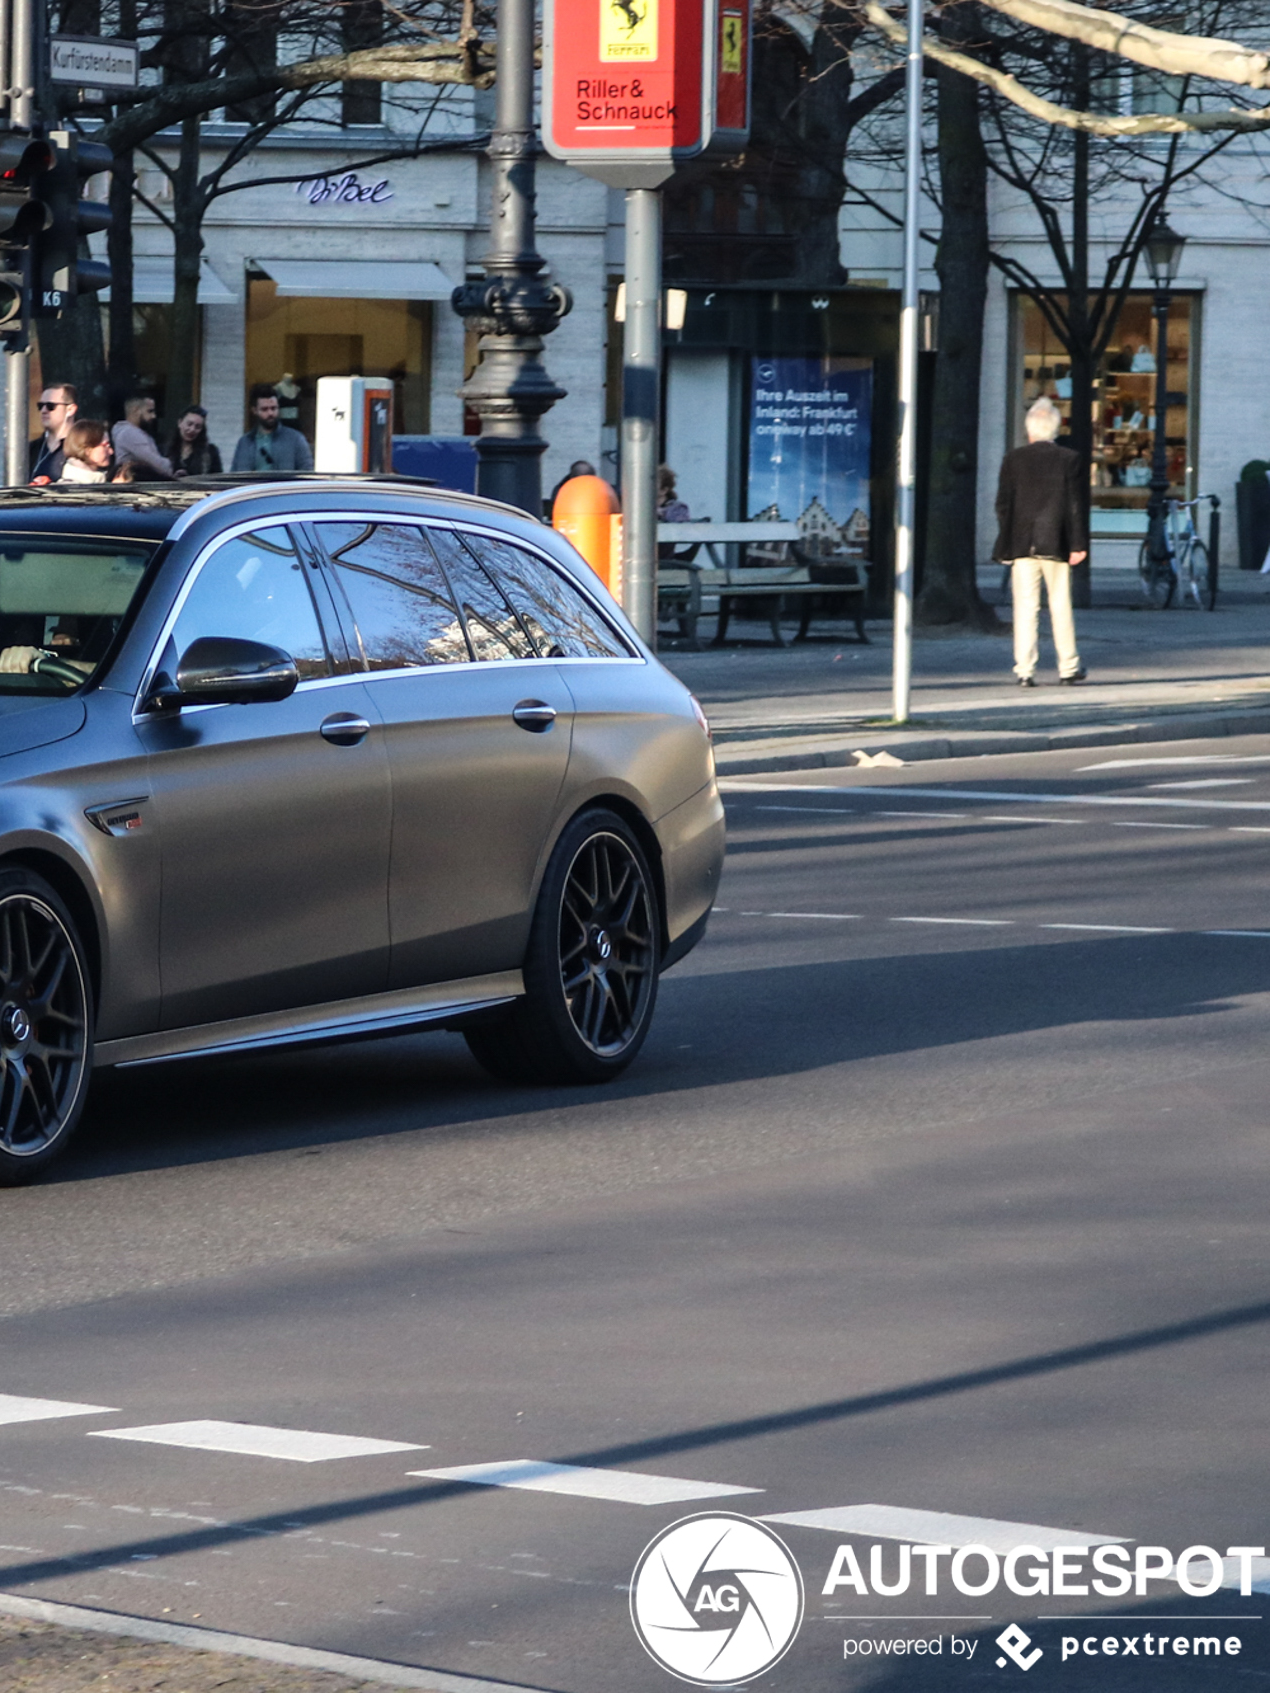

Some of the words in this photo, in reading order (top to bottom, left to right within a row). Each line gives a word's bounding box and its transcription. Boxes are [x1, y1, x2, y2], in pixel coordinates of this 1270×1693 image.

[607, 44, 650, 56] Ferrari
[52, 46, 133, 75] Kurfürstendamm
[577, 101, 679, 121] Schnauck
[43, 291, 61, 307] K6
[756, 389, 783, 402] Ihre
[785, 388, 831, 402] Auszeit
[833, 389, 849, 402] im
[802, 405, 858, 419] Frankfurt
[809, 422, 824, 435] ab
